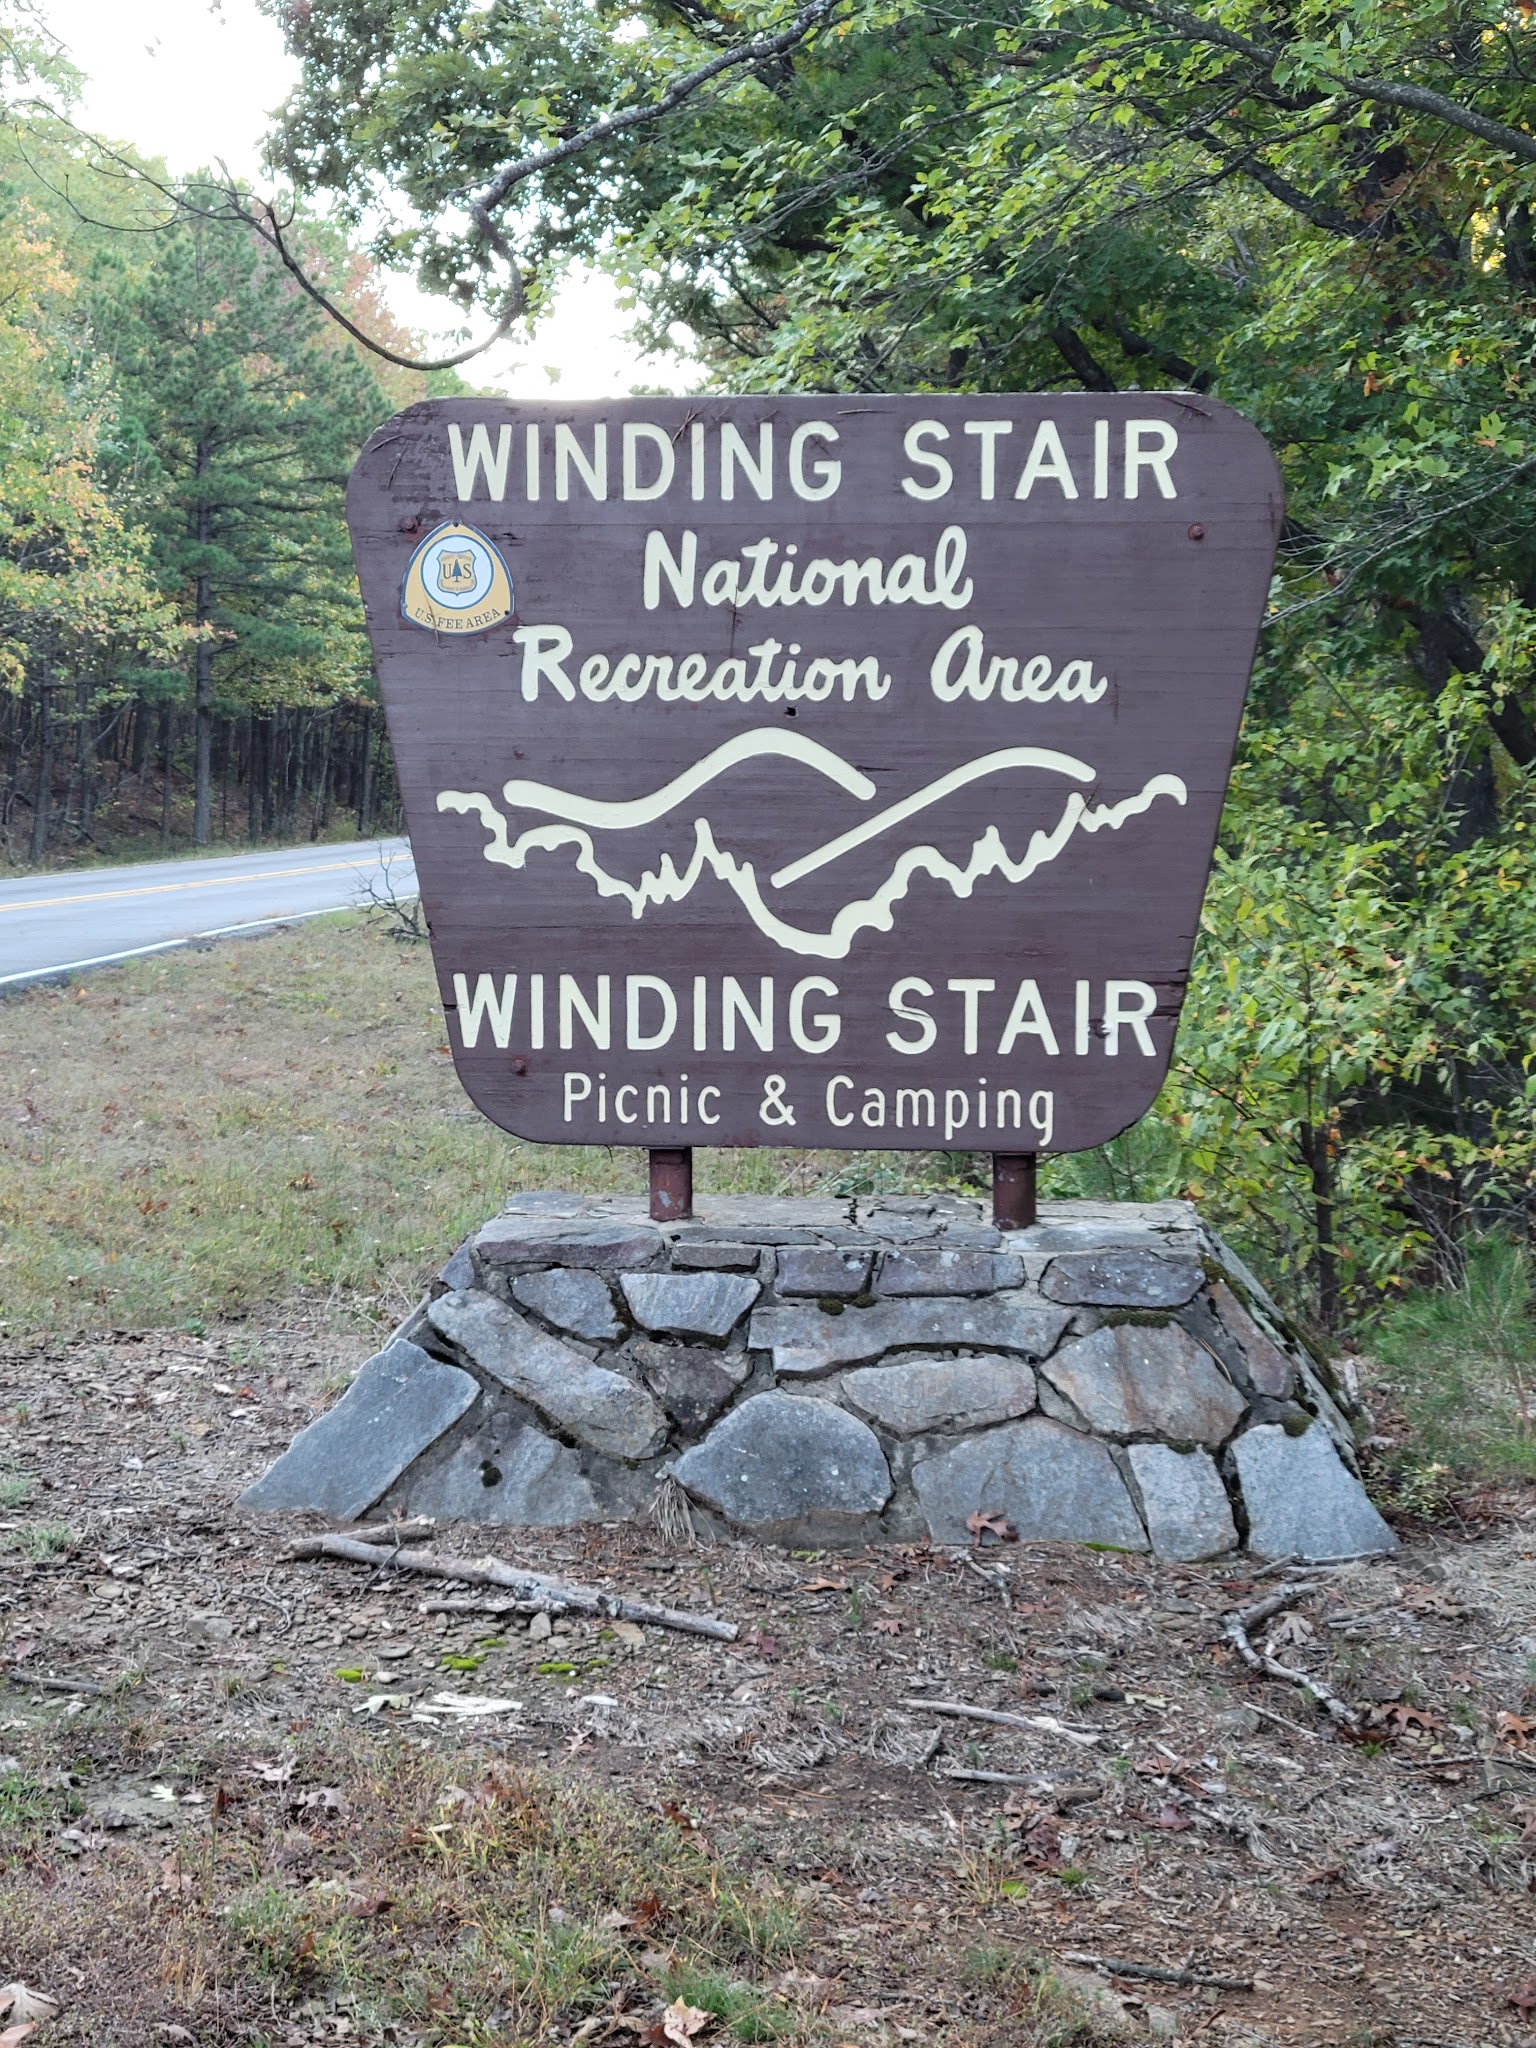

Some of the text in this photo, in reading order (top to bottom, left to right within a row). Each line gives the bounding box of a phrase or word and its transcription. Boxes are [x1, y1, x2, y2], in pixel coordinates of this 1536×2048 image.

[447, 419, 1179, 503] WINDING STAIR
[643, 525, 974, 611] National
[437, 616, 463, 630] FEE
[466, 608, 501, 629] AREA
[512, 624, 1108, 704] Recreation Area
[452, 973, 1157, 1057] WINDING STAIR
[563, 1072, 1055, 1148] Picnic & Camping
